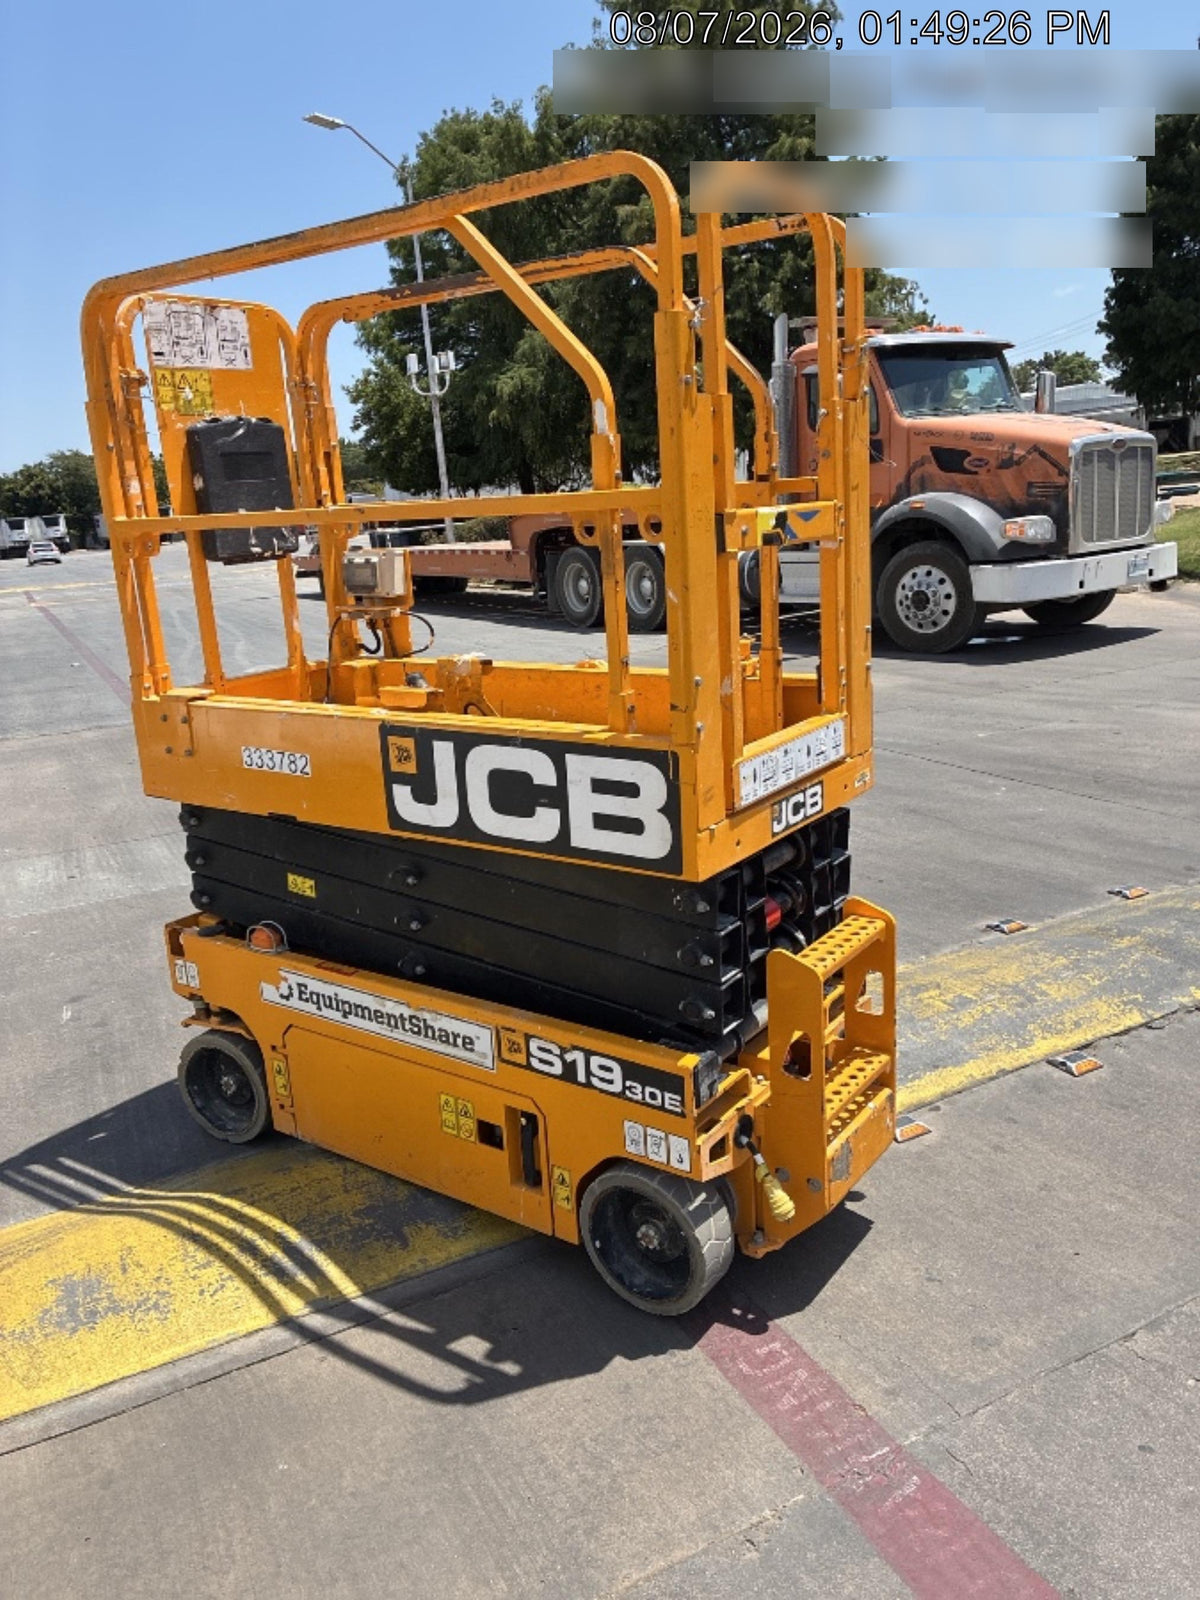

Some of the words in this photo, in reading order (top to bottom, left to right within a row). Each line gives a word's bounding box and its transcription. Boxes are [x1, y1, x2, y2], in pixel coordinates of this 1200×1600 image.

[242, 747, 310, 776] 333782
[392, 740, 673, 860] JCB
[772, 784, 823, 834] JCB
[296, 982, 476, 1053] EquipmentShare
